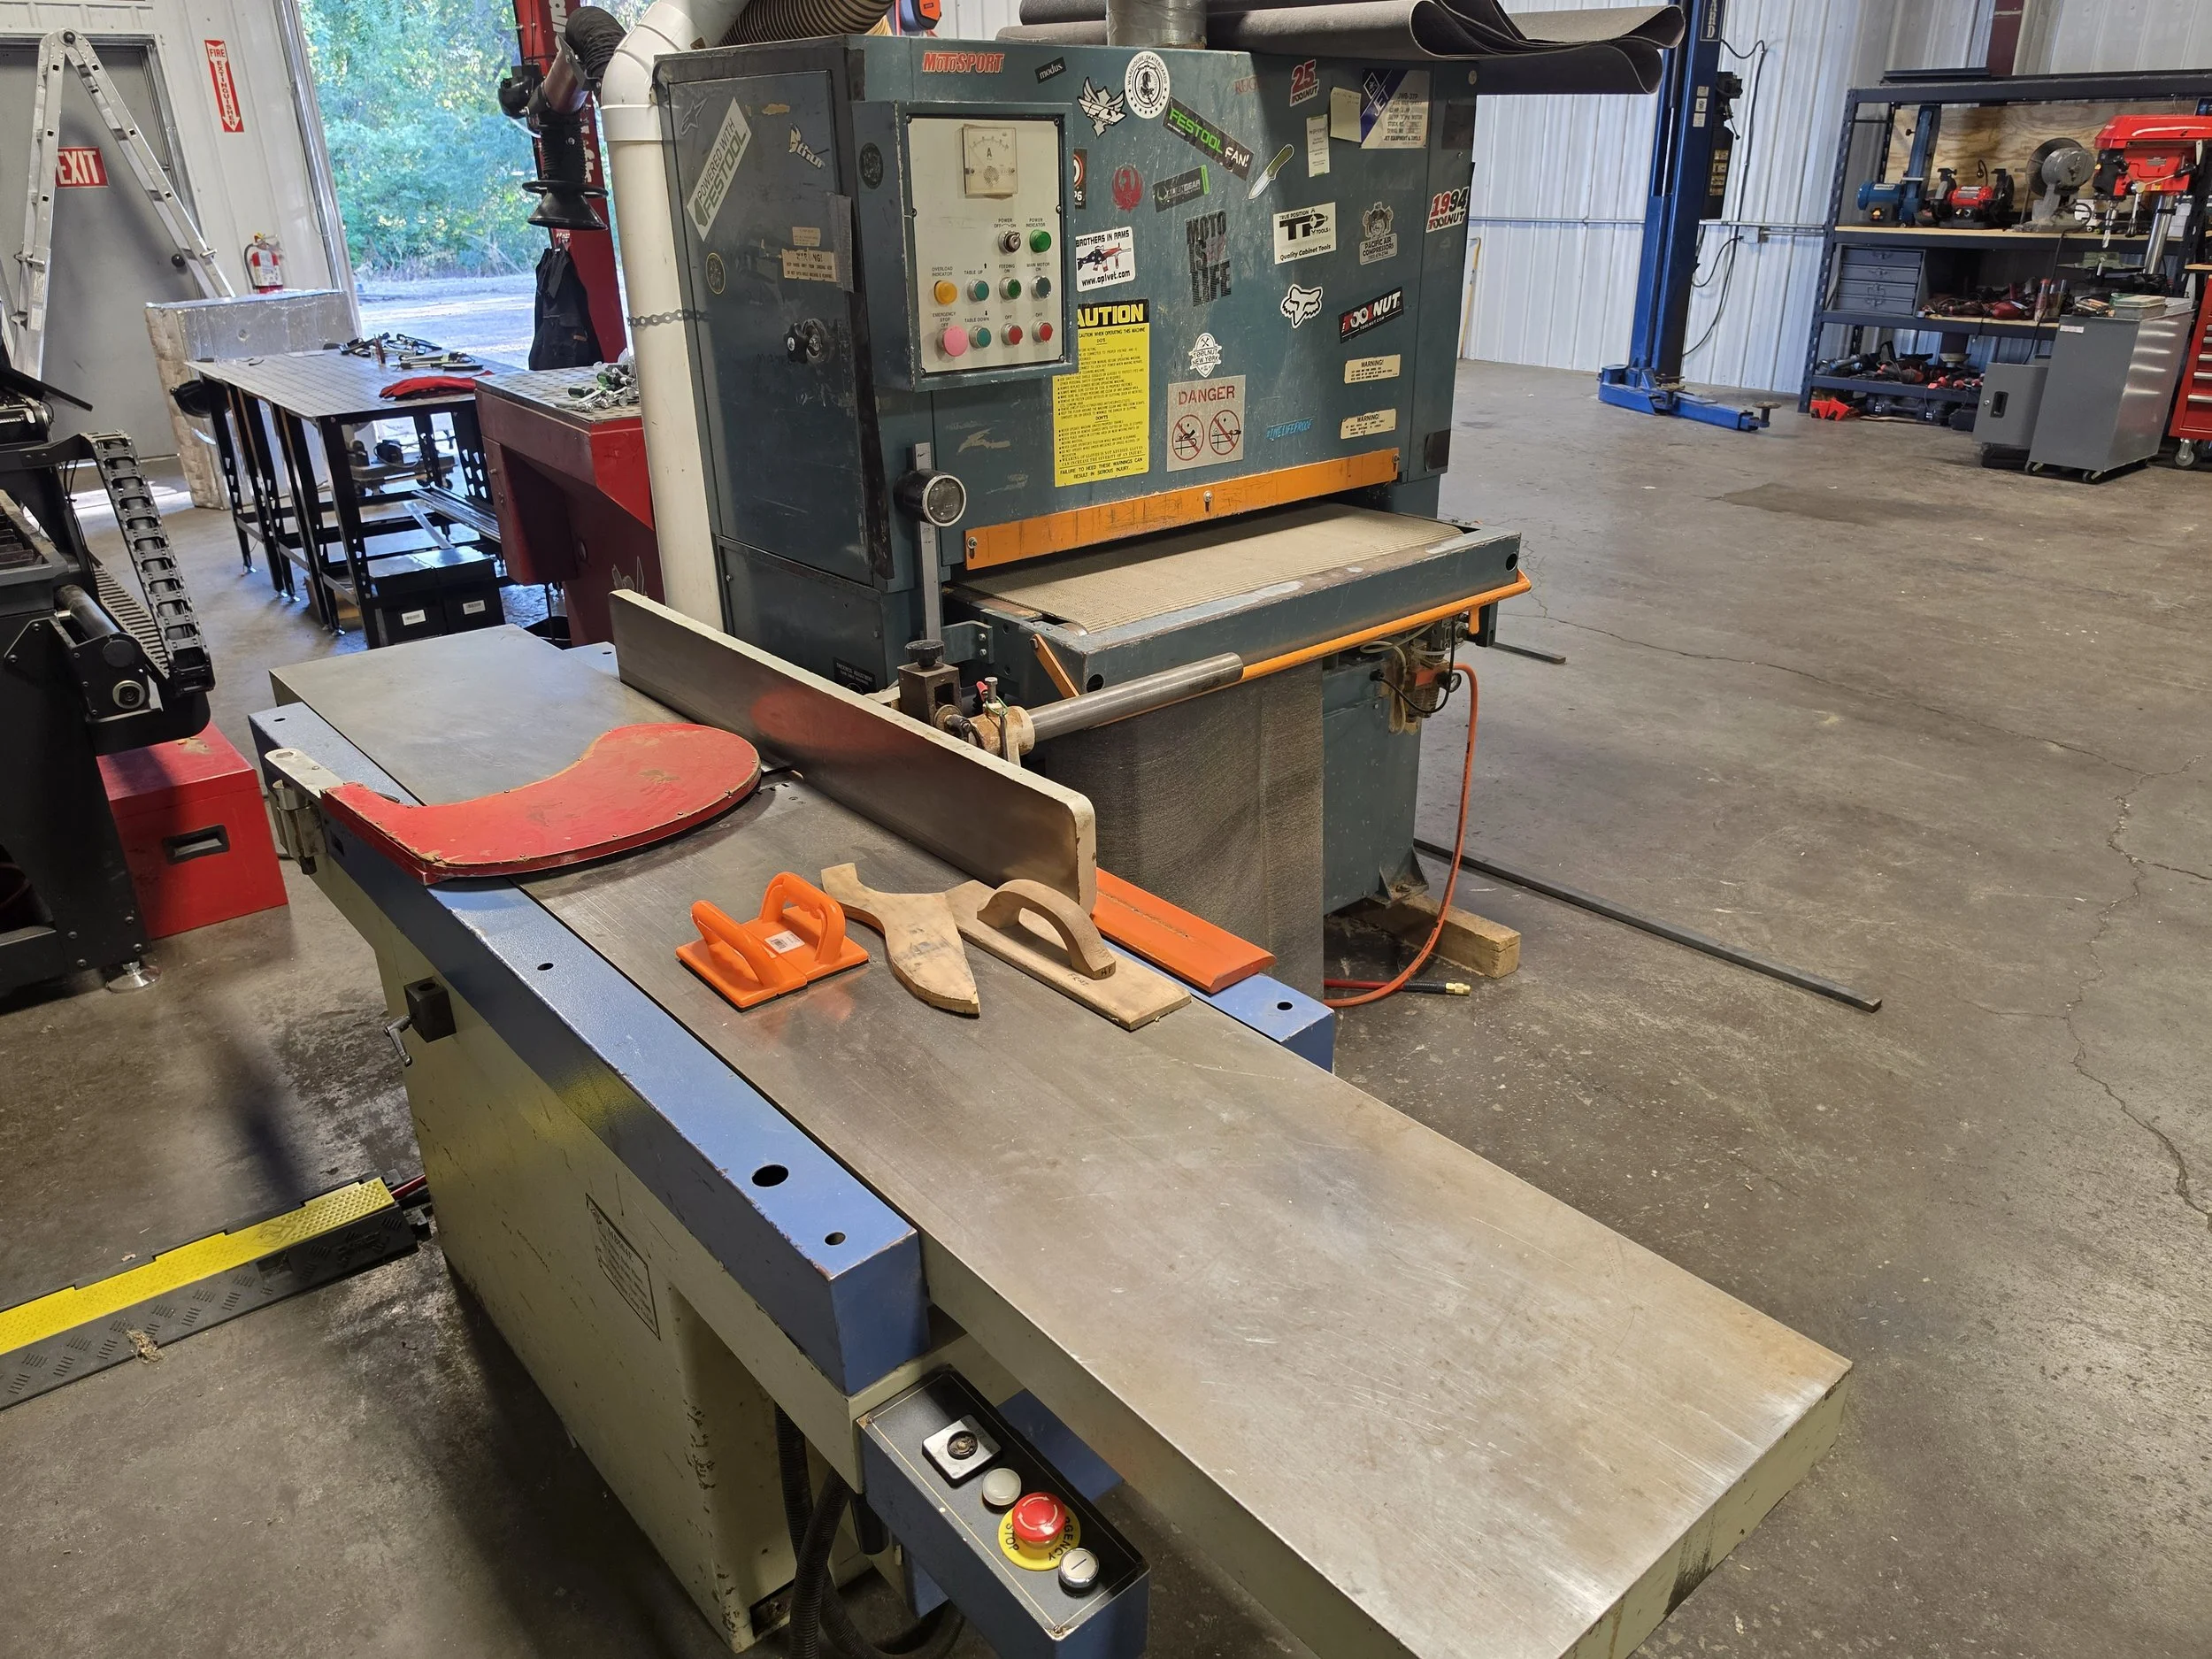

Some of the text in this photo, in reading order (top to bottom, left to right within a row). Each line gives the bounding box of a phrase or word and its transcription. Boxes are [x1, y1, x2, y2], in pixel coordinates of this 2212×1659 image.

[209, 49, 226, 58] FIRE
[1128, 55, 1144, 85] WAREHOUSE
[1292, 60, 1316, 94] 25
[216, 60, 237, 126] EXTINGUISHER
[1373, 85, 1390, 117] JET
[1169, 107, 1249, 167] FESTOOL FAN!
[57, 150, 100, 185] EXIT
[697, 118, 736, 204] POWERED WITH
[702, 130, 748, 219] FESTOOL
[1430, 188, 1469, 218] 1994
[1186, 211, 1226, 245] MOTO
[1429, 211, 1465, 230] TOOLNUT
[1075, 234, 1105, 248] BROTHERS
[1114, 230, 1130, 240] ARMS
[1279, 251, 1298, 261] Quality
[1298, 247, 1317, 256] Cabinet
[1363, 242, 1394, 257] COMPRESSORS
[1364, 239, 1383, 249] PACIFIC
[1191, 260, 1233, 307] LIFE
[1344, 291, 1401, 332] TOOLNUT
[1192, 357, 1203, 365] NEW
[1361, 359, 1384, 368] WARNING!
[1178, 385, 1235, 405] DANGER
[1356, 413, 1380, 423] WARNING!
[1004, 1523, 1020, 1552] STOP
